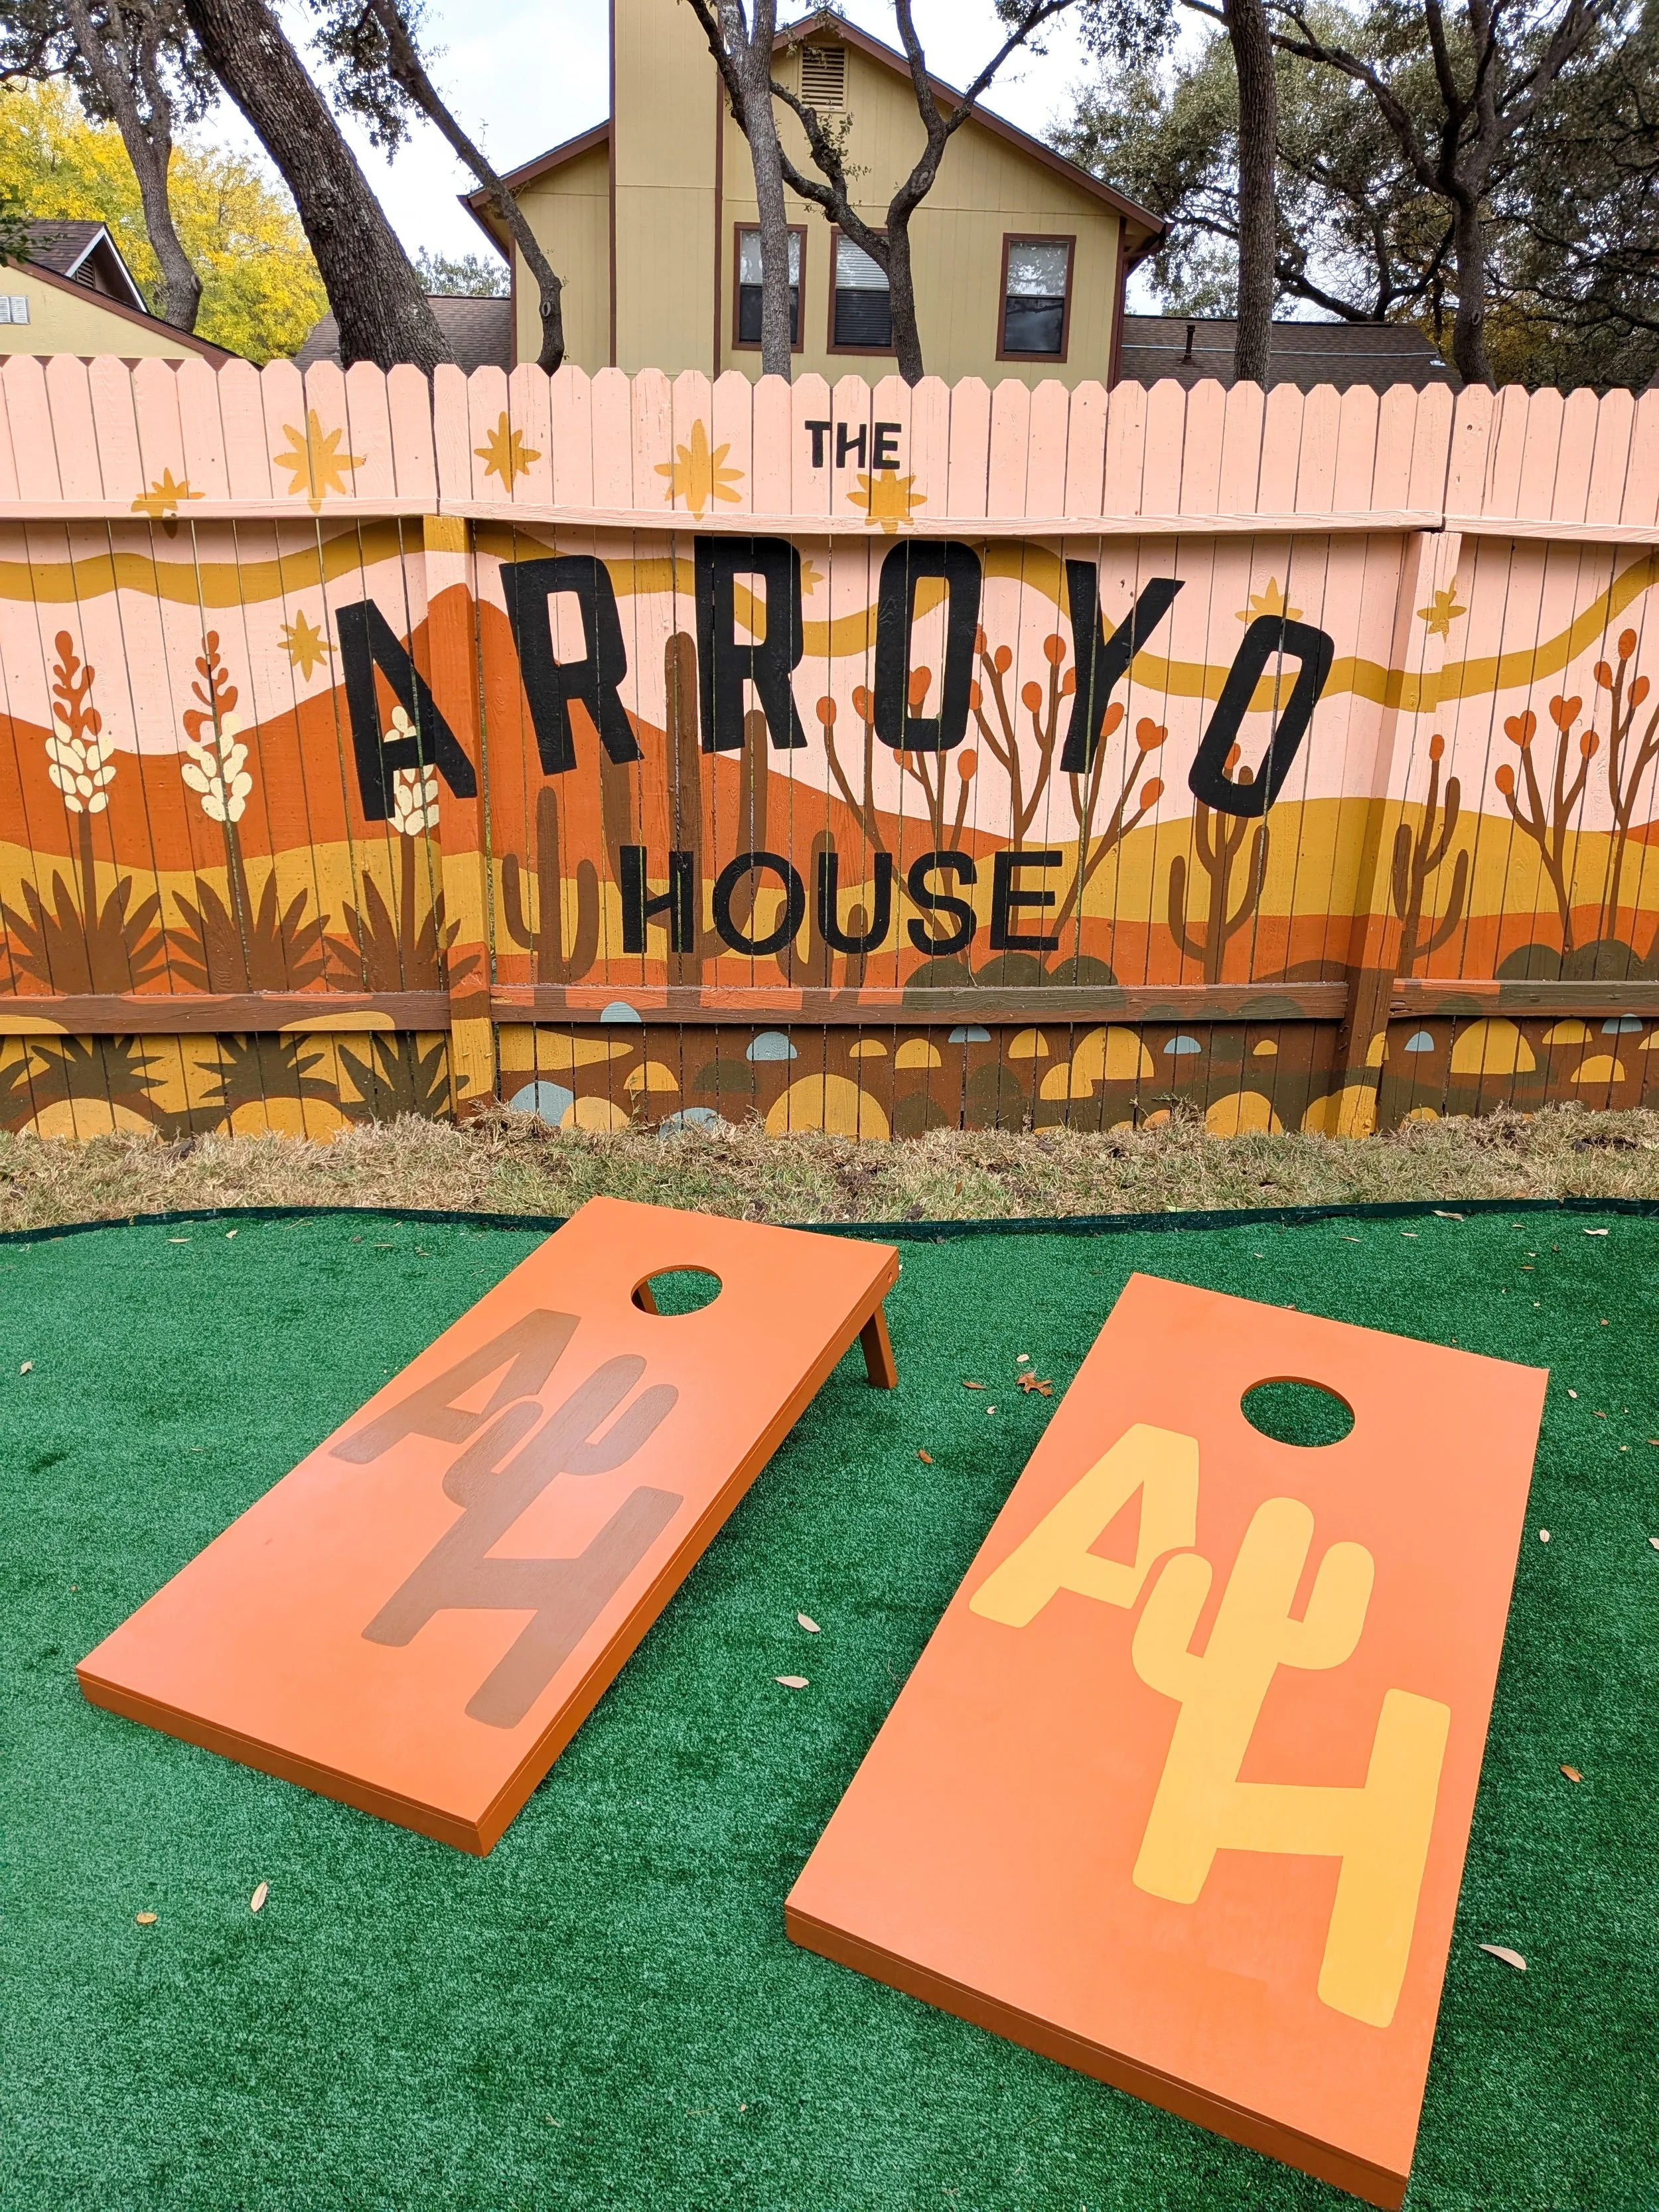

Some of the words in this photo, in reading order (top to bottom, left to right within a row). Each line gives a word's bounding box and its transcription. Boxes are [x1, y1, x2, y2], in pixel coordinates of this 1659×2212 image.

[805, 420, 902, 469] THE
[335, 535, 1335, 821] ARROYO
[620, 846, 1063, 956] HOUSE
